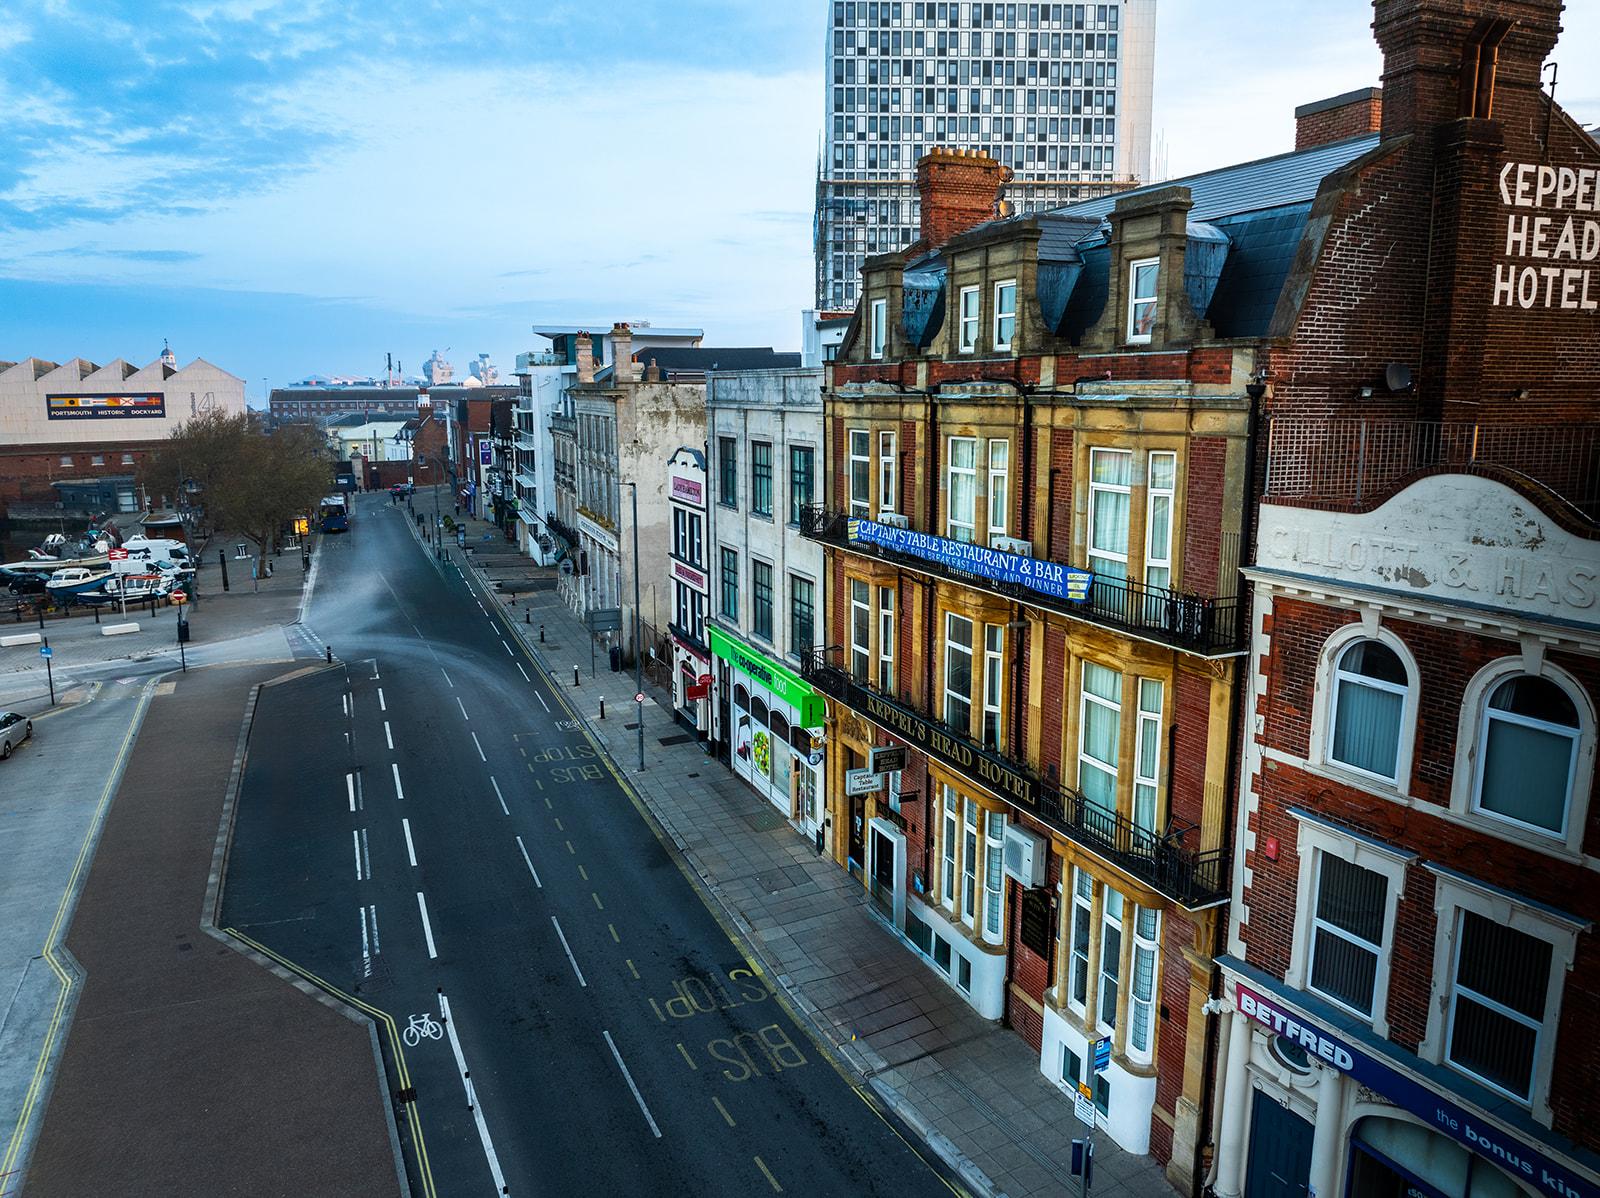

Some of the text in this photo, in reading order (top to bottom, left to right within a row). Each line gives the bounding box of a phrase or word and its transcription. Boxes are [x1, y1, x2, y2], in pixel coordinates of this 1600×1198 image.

[1506, 214, 1600, 261] HEAD
[1493, 264, 1598, 309] HOTEL
[906, 531, 939, 552] TABLE
[941, 540, 1019, 571] RESTAURANT
[1020, 558, 1031, 575] &
[1035, 561, 1063, 583] BAR
[911, 546, 926, 559] FOR
[973, 562, 1000, 579] LUNCH
[1003, 571, 1020, 583] AND
[1024, 576, 1063, 596] DINNER
[1441, 554, 1479, 592] &
[739, 654, 772, 686] co-operative
[773, 671, 787, 696] food
[534, 744, 597, 763] STOP
[866, 694, 1036, 805] KEPPEL'S HEAD HOTEL
[550, 764, 604, 783] BUS
[852, 783, 879, 792] Restaurant
[859, 778, 873, 786] Table
[665, 969, 768, 1018] STOP
[707, 1024, 808, 1082] BUS
[1241, 992, 1354, 1071] BETFRED
[1436, 1108, 1458, 1130] the
[1465, 1124, 1534, 1175] bonus
